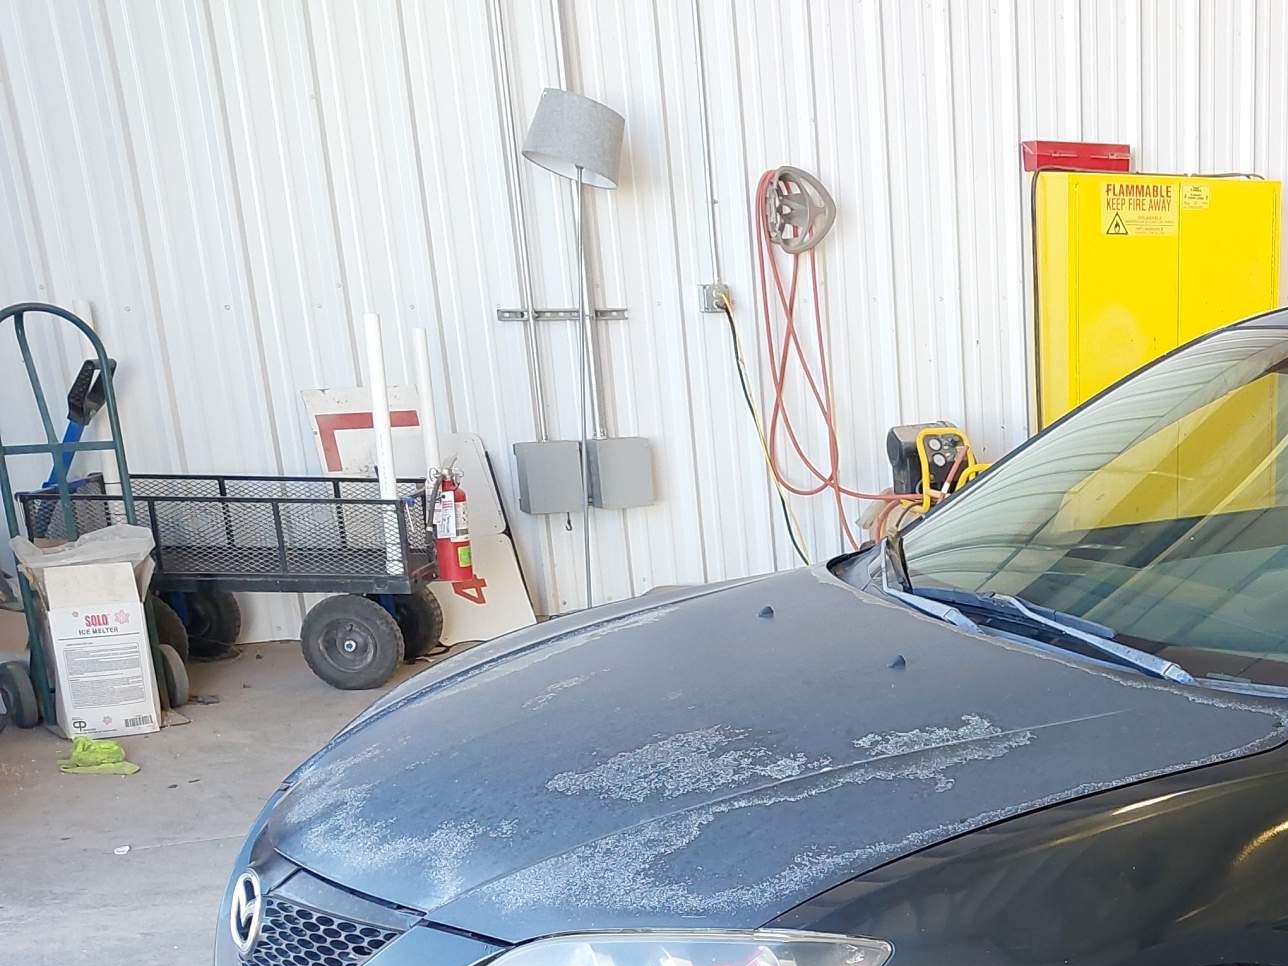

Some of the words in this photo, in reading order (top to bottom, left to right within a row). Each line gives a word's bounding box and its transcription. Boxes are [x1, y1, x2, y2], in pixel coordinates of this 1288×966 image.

[1106, 184, 1172, 199] FLAMMABLE
[1106, 198, 1126, 211] KEEP
[1128, 198, 1147, 211] FIRE
[1148, 199, 1171, 212] AWAY
[84, 614, 110, 627] SOLO
[78, 628, 92, 636] ICE
[93, 626, 119, 635] MELTER
